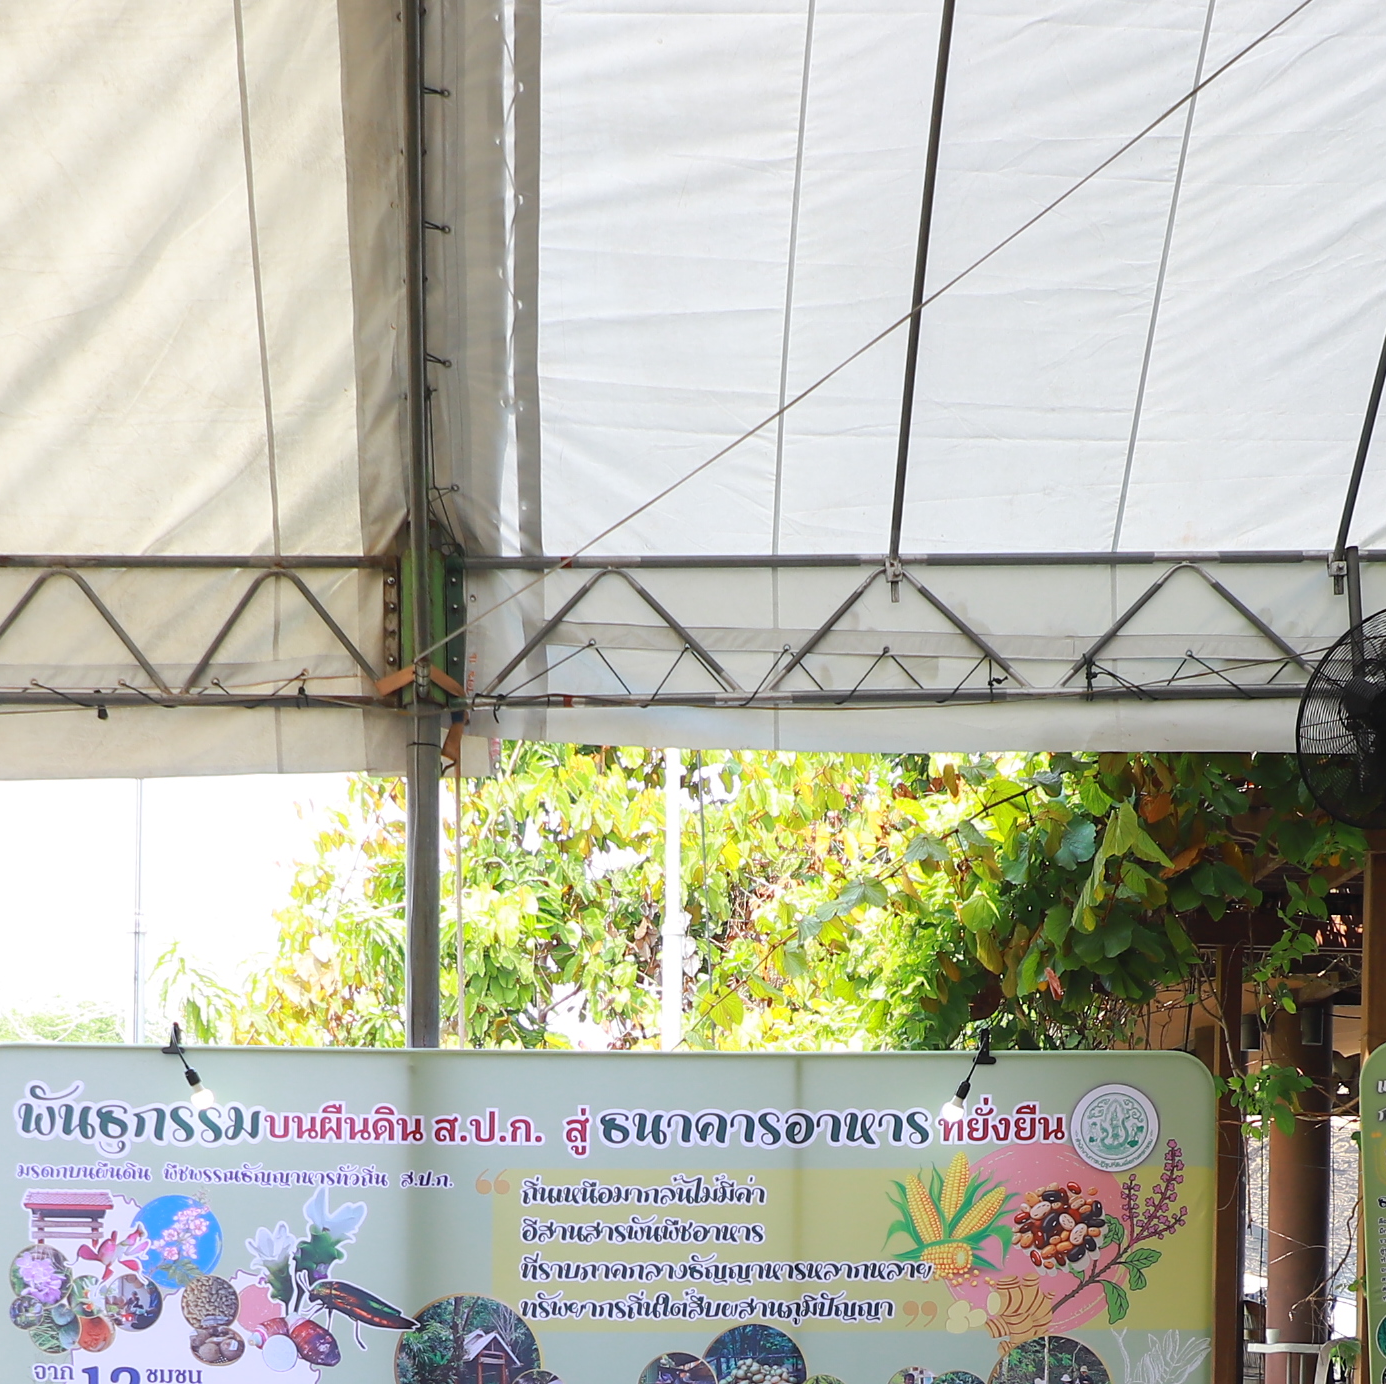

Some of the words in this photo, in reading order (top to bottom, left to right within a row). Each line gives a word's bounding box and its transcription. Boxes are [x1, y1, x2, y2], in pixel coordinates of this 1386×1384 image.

[433, 1110, 543, 1143] ส.ป.ก.
[564, 1107, 591, 1156] สู่
[16, 1161, 152, 1182] มรดกบนผืนดิน
[163, 1164, 389, 1188] พืชพรรณธัญญาหารทั่วถิ่น
[401, 1169, 455, 1189] ส.ป.ก.
[520, 1175, 767, 1205] ถิ่นเหนือมากล้นไม้มีค่า
[520, 1214, 765, 1244] อีสานสารพันพืชอาหาร
[520, 1252, 936, 1284] ที่ราบภาคกลางธัญญาหารหลากหลาย
[33, 1364, 75, 1381] จาก
